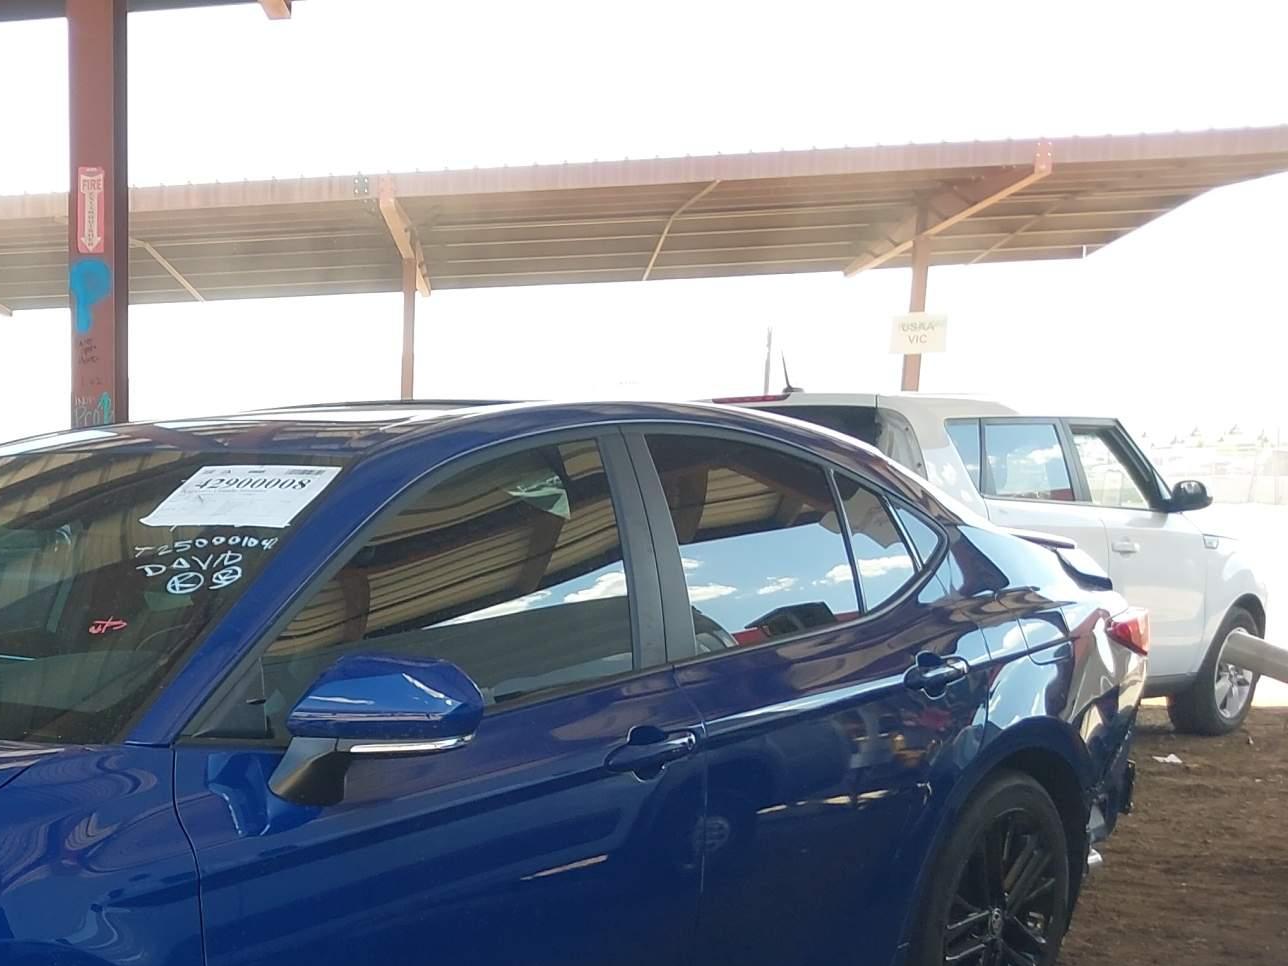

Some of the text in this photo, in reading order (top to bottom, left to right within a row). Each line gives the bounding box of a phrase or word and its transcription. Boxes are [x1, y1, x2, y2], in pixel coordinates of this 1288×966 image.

[83, 179, 102, 190] FIRE
[907, 334, 928, 345] VIC
[195, 478, 311, 489] 42900008
[135, 550, 242, 577] DAVID
